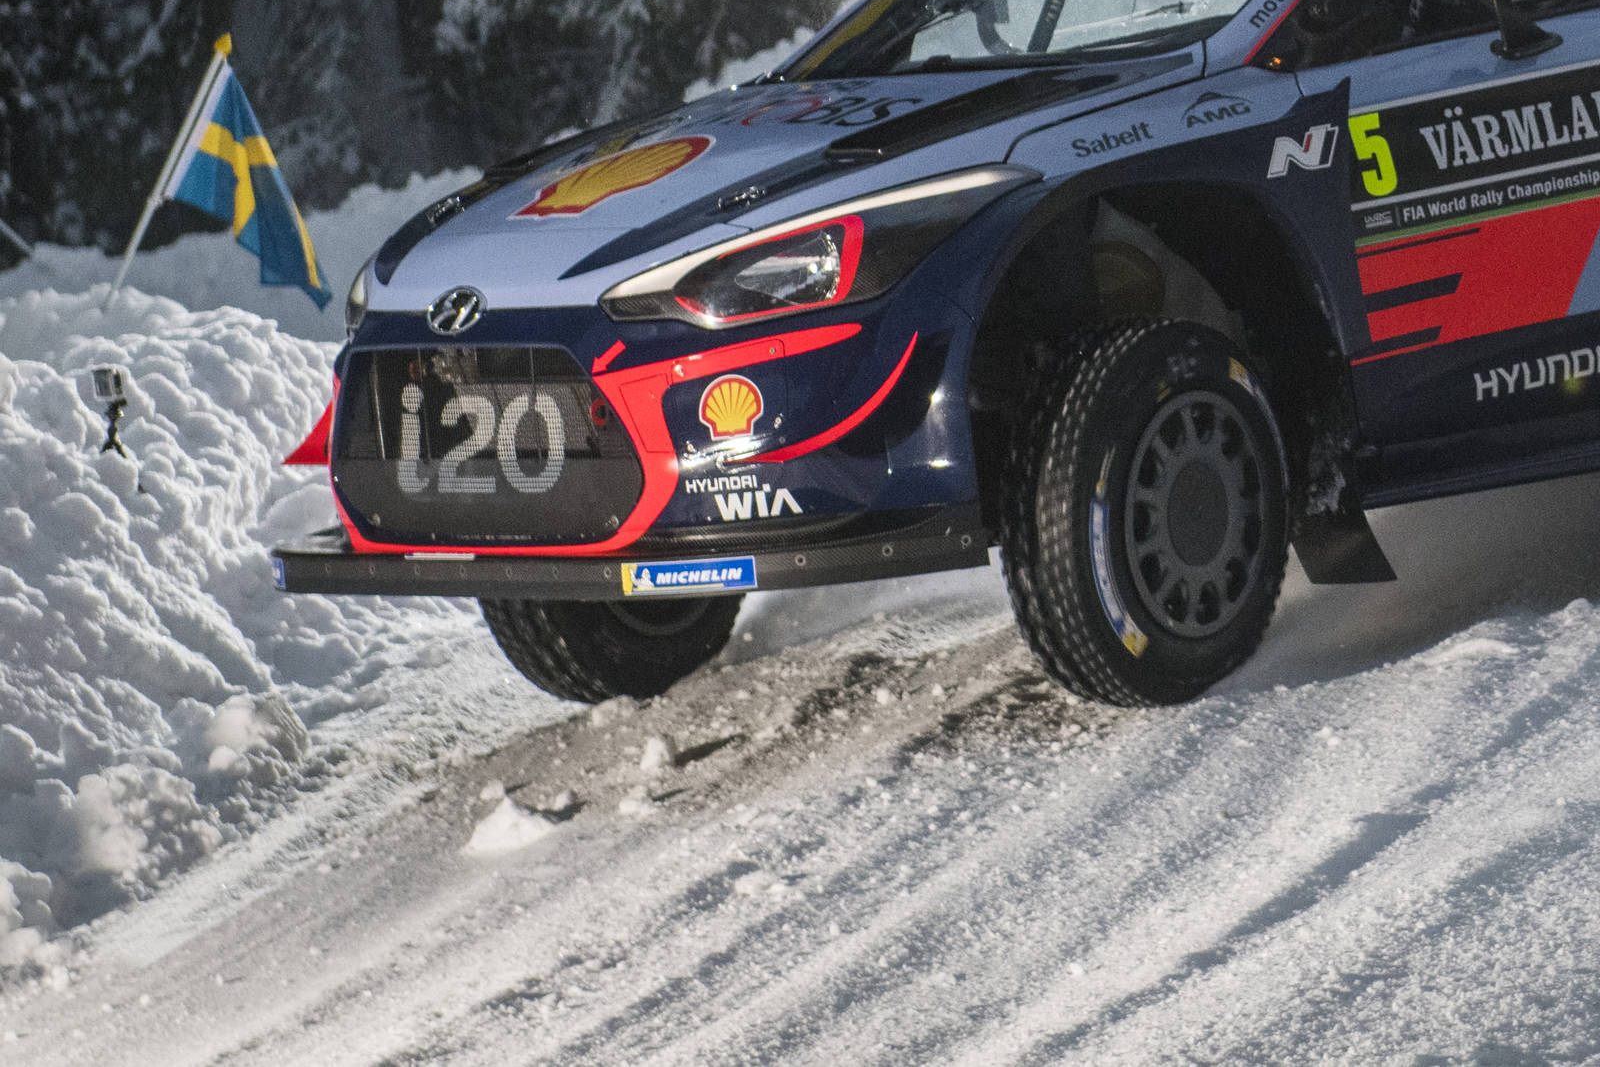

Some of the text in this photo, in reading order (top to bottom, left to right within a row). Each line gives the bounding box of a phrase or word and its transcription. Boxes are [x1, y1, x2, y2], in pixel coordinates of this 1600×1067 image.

[1186, 102, 1251, 129] AMG
[1071, 121, 1154, 158] Sabelt
[1348, 112, 1398, 197] 5
[1403, 171, 1600, 222] FIA World Rally Championship
[397, 383, 566, 493] i20
[685, 474, 758, 494] HYUNDAI
[714, 483, 804, 522] WIA
[656, 567, 743, 585] MICHELIN
